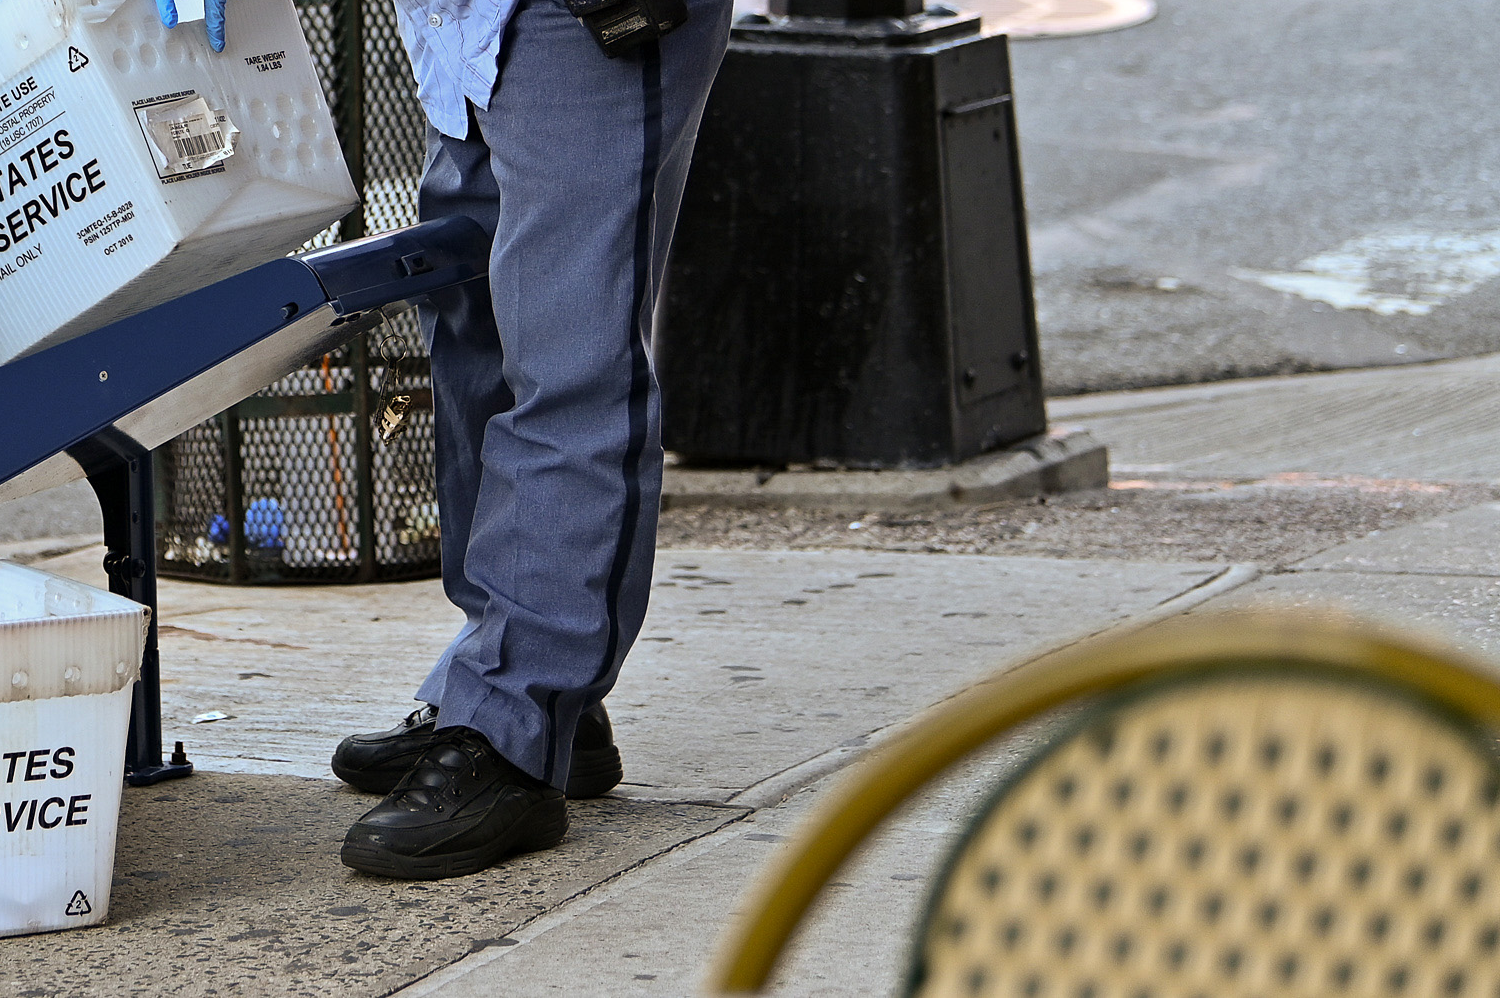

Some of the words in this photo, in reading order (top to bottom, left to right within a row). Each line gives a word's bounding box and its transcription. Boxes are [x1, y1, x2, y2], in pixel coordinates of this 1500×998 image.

[244, 56, 262, 66] TARE
[261, 50, 286, 63] WEIGHT
[269, 61, 283, 70] LBS
[10, 76, 38, 101] USE
[18, 90, 56, 121] PROPERTY
[9, 127, 26, 142] USC
[25, 115, 44, 133] 1707)
[83, 232, 100, 246] PSIN
[103, 242, 118, 256] OCT
[117, 233, 134, 248] 2018
[15, 243, 44, 268] ONLY
[76, 899, 82, 909] 2
